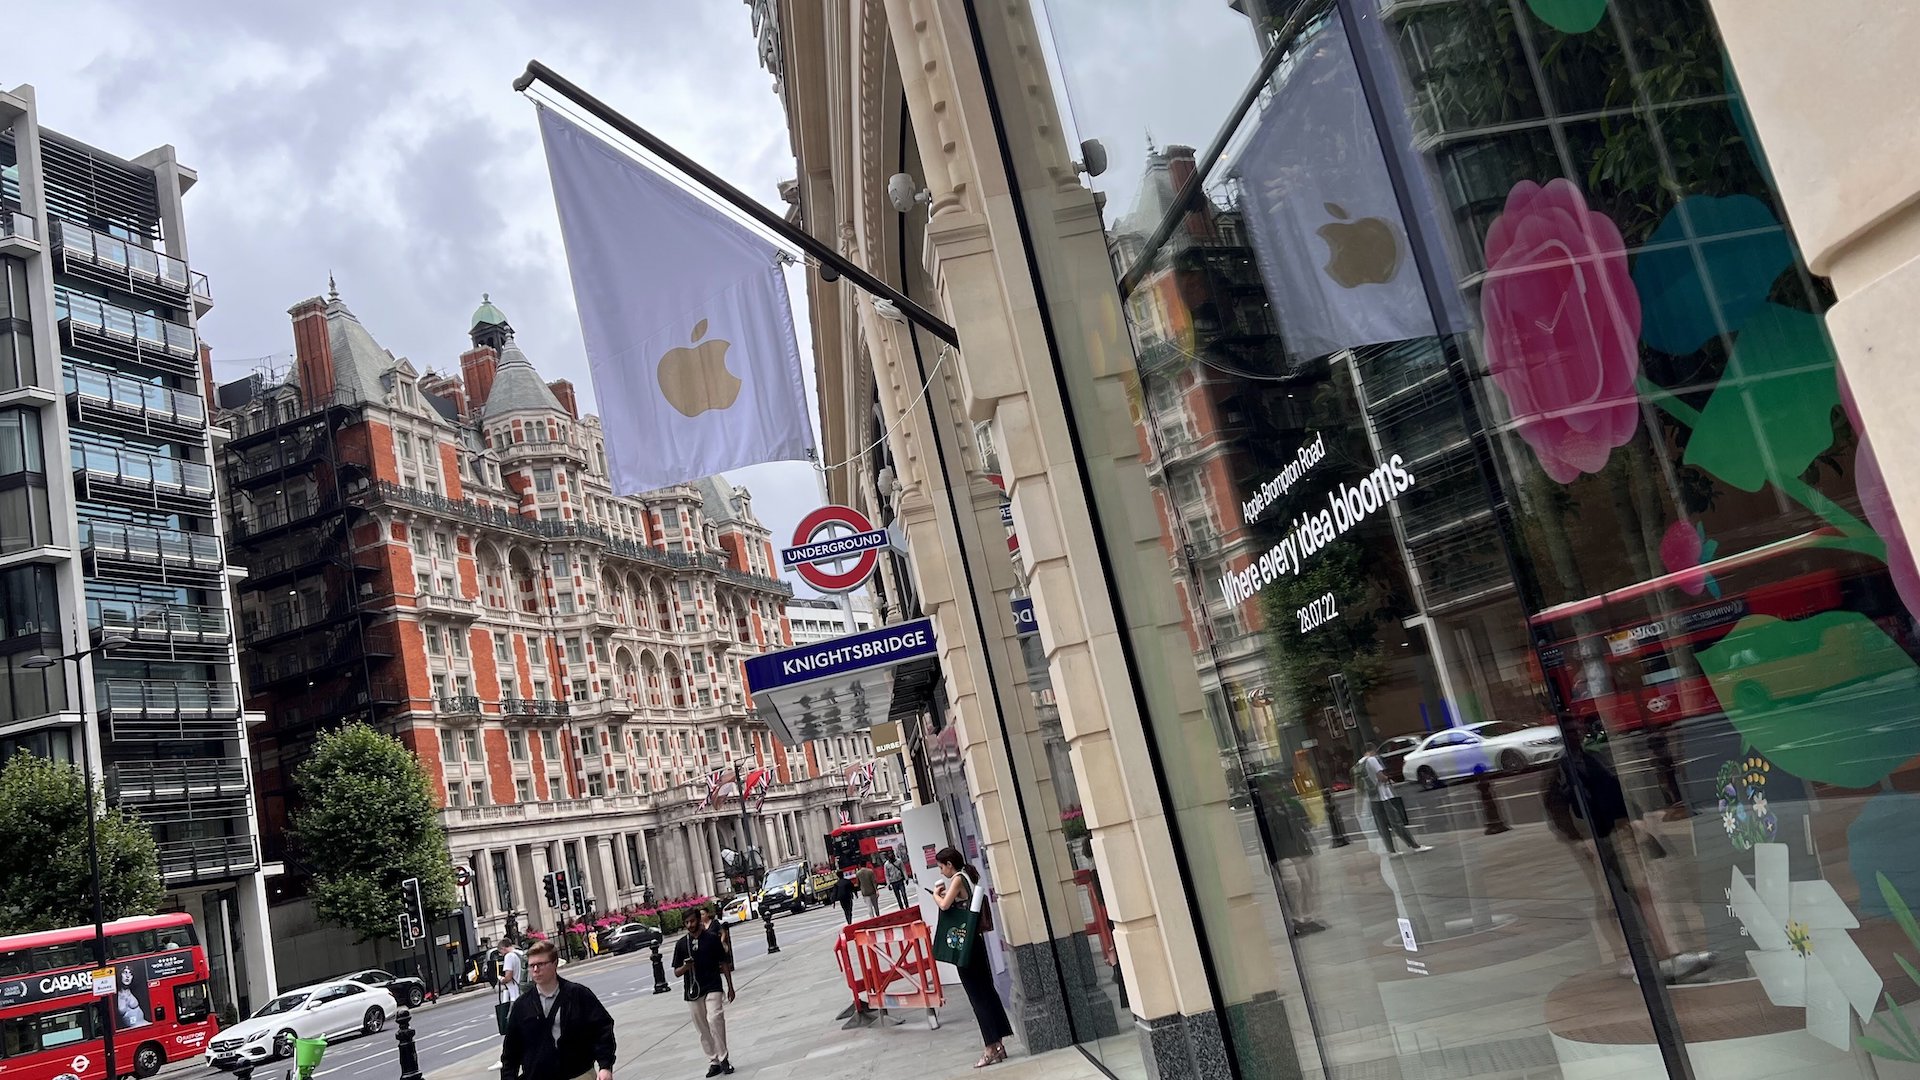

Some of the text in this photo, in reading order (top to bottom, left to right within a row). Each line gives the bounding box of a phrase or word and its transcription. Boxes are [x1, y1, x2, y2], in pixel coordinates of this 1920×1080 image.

[1242, 431, 1326, 524] Apple Brompton Road
[787, 533, 882, 562] UNDERGROUND
[1218, 454, 1415, 610] Where every idea blooms.
[1296, 592, 1339, 634] 28.07.22
[783, 630, 927, 675] KNIGHTSBRIDGE
[876, 741, 901, 753] BURBE
